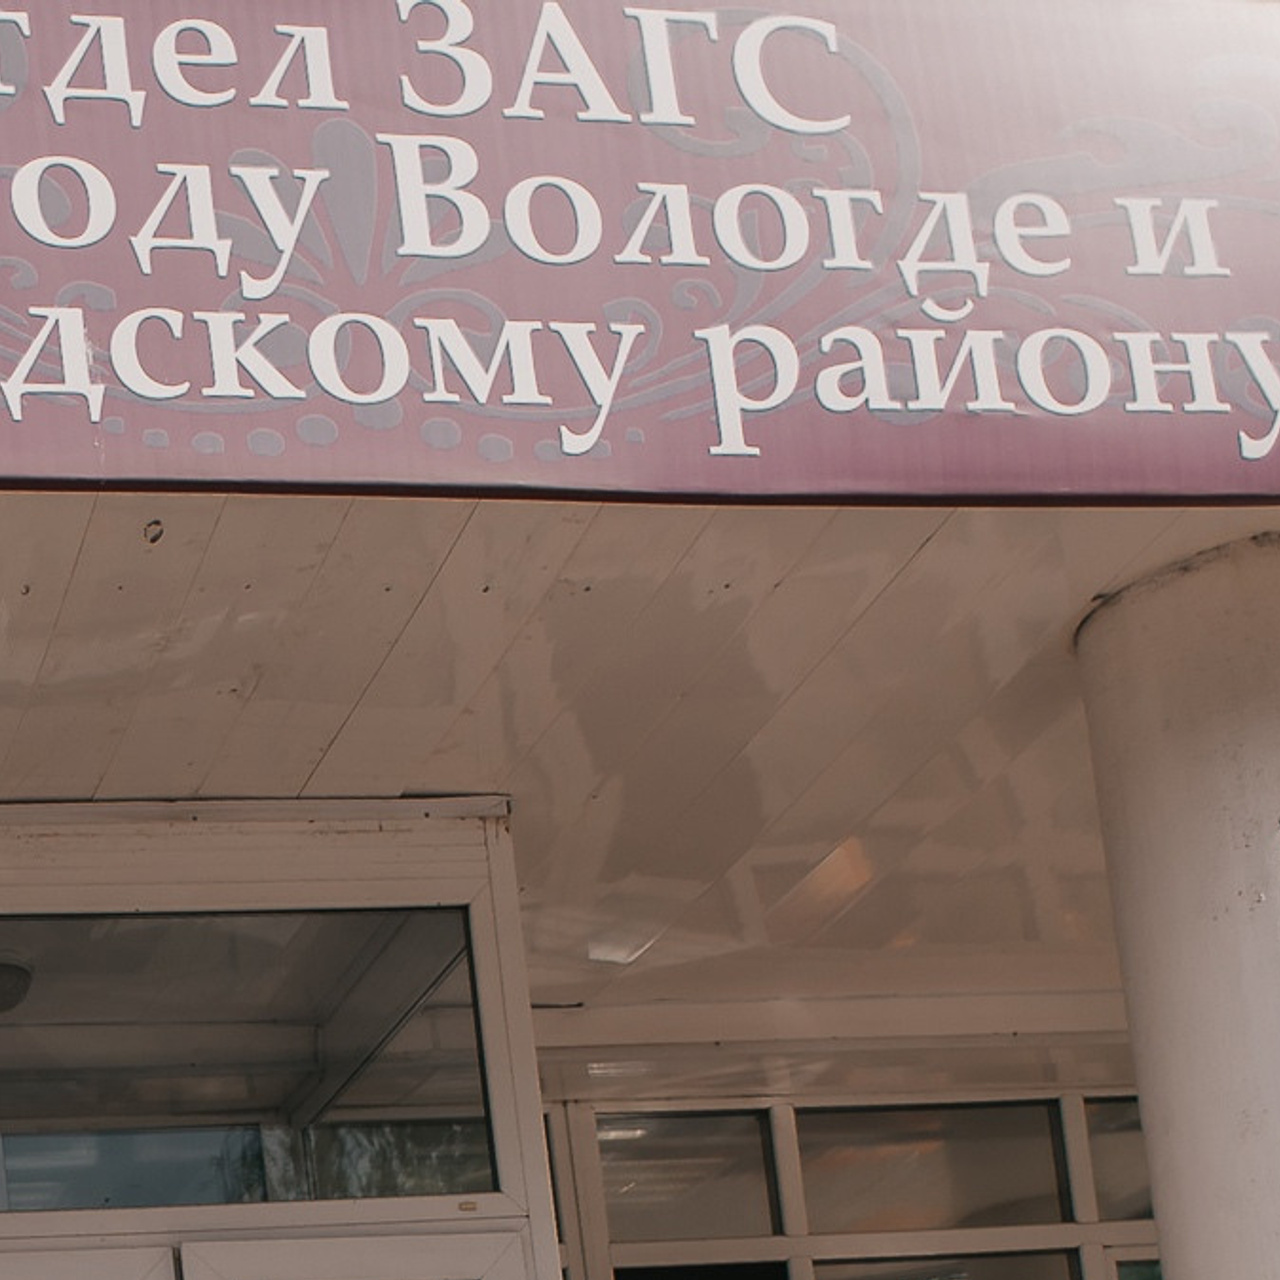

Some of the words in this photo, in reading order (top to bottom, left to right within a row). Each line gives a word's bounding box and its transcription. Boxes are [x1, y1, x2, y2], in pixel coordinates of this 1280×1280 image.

[396, 0, 852, 133] ЗАГС
[376, 132, 1072, 297] Вологде
[1115, 197, 1231, 277] и
[694, 297, 1280, 460] району
